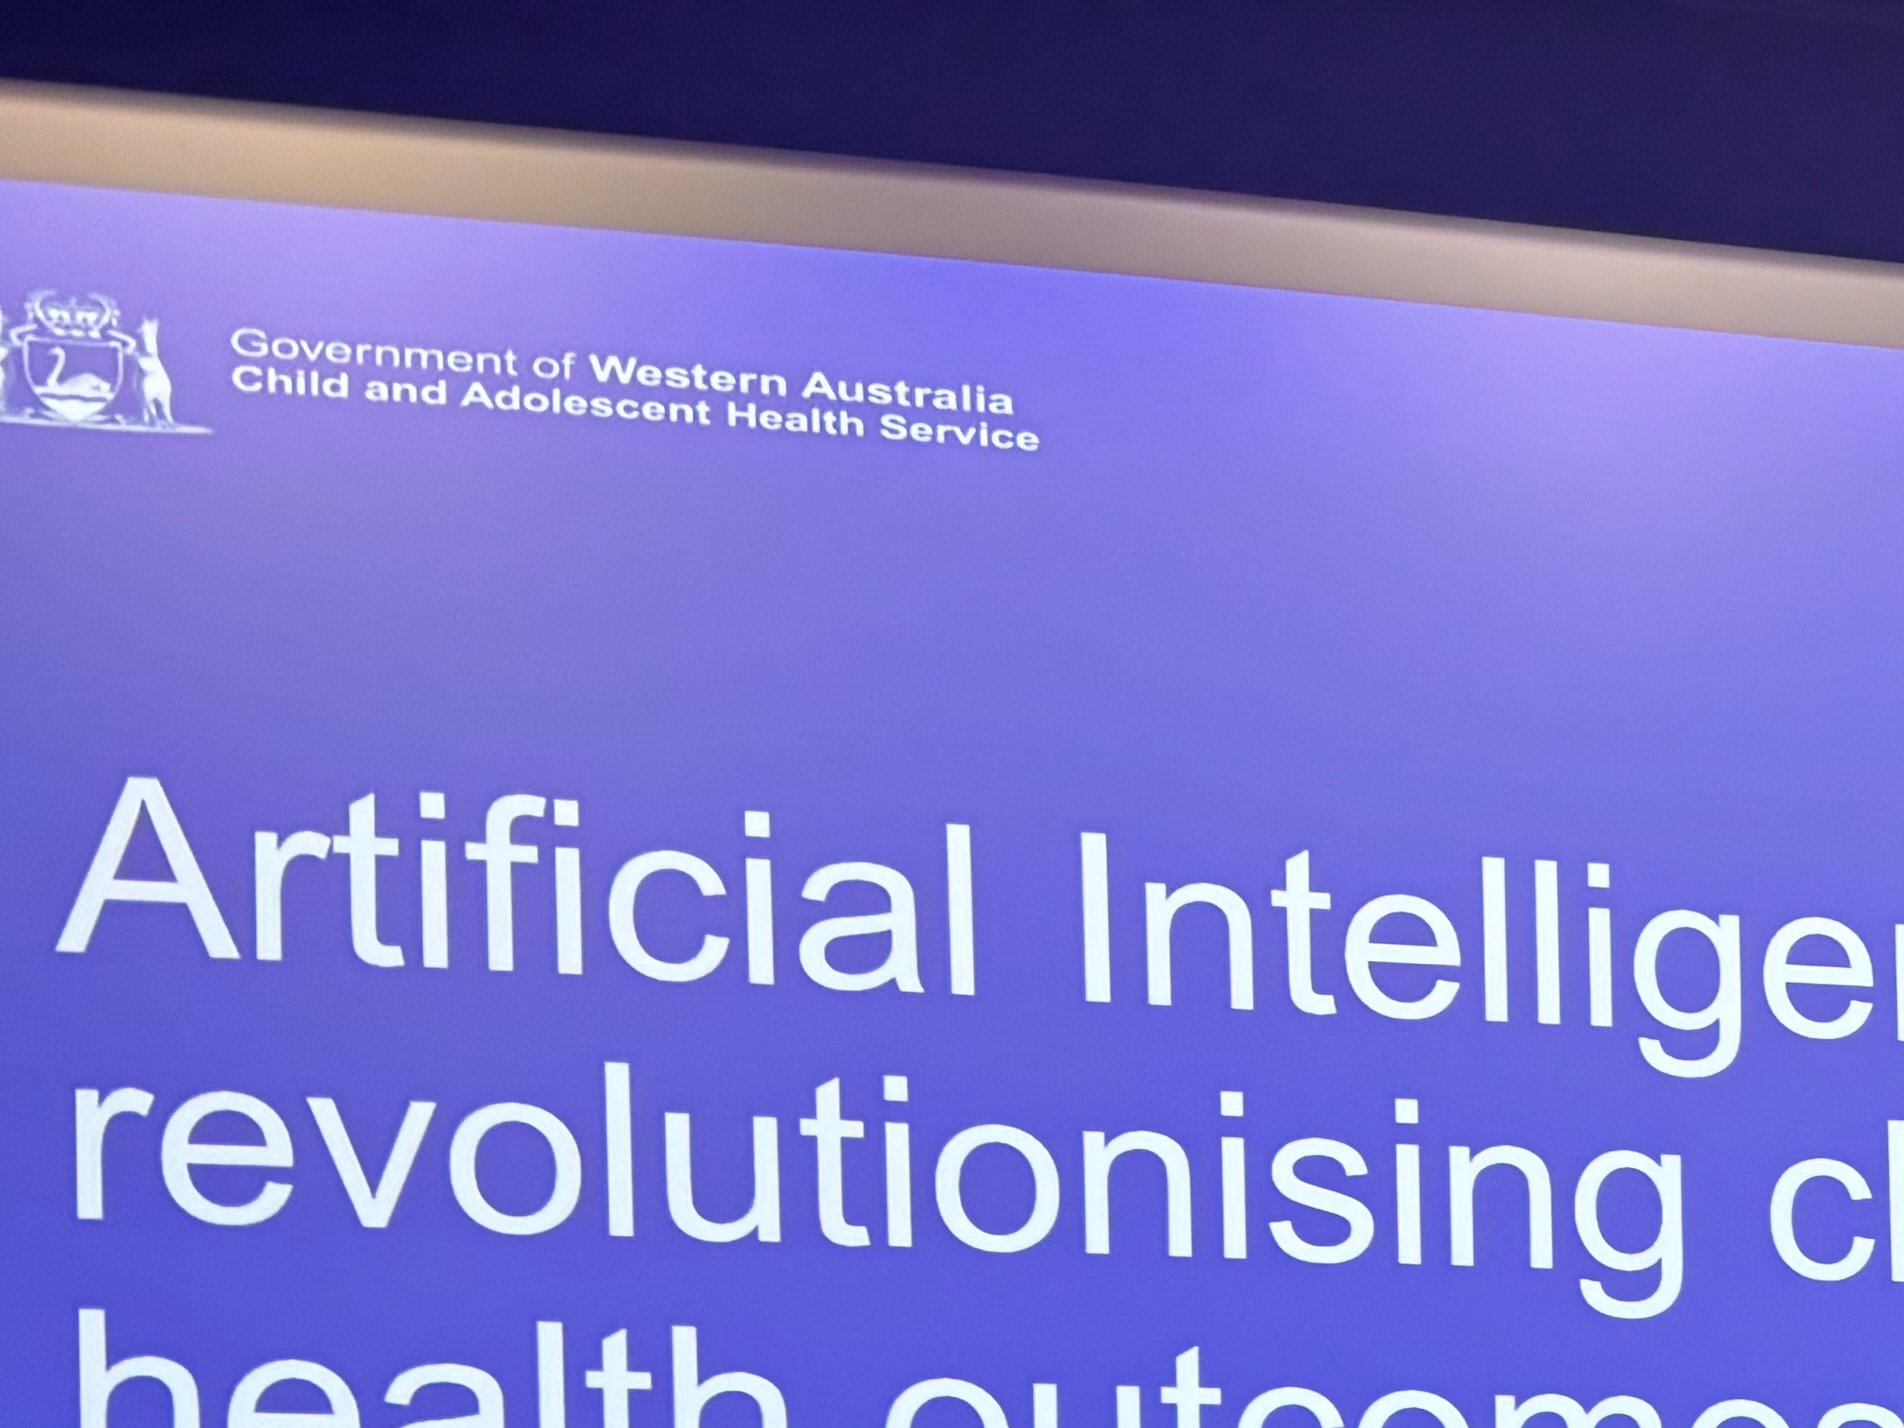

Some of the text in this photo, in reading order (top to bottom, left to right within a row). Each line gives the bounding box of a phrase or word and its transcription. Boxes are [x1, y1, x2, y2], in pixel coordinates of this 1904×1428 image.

[231, 327, 1013, 415] Government of Western Australia
[232, 365, 1040, 451] Child and Adolescent Health Service
[55, 773, 979, 1000] Artificial
[71, 1061, 1686, 1320] revolutionising
